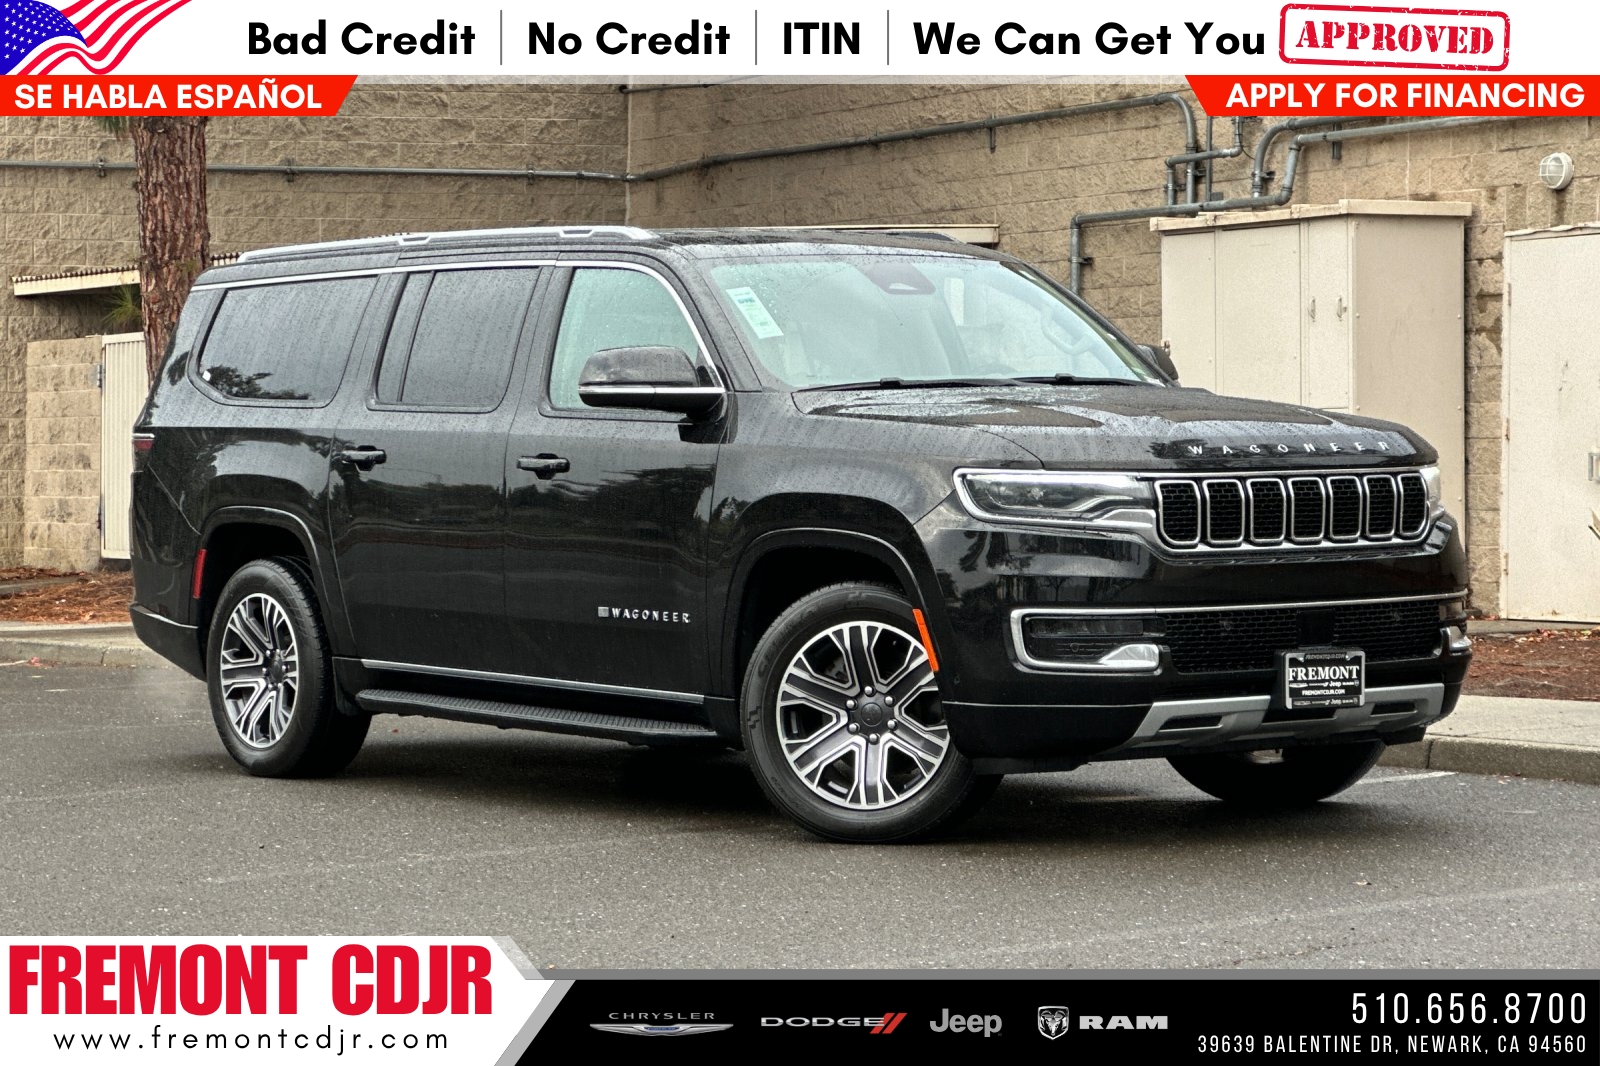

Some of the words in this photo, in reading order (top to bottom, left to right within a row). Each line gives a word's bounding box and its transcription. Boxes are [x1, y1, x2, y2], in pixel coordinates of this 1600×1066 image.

[1187, 441, 1391, 455] WAGONEER
[611, 607, 690, 623] WAGONEER
[1288, 666, 1359, 680] FREMONT
